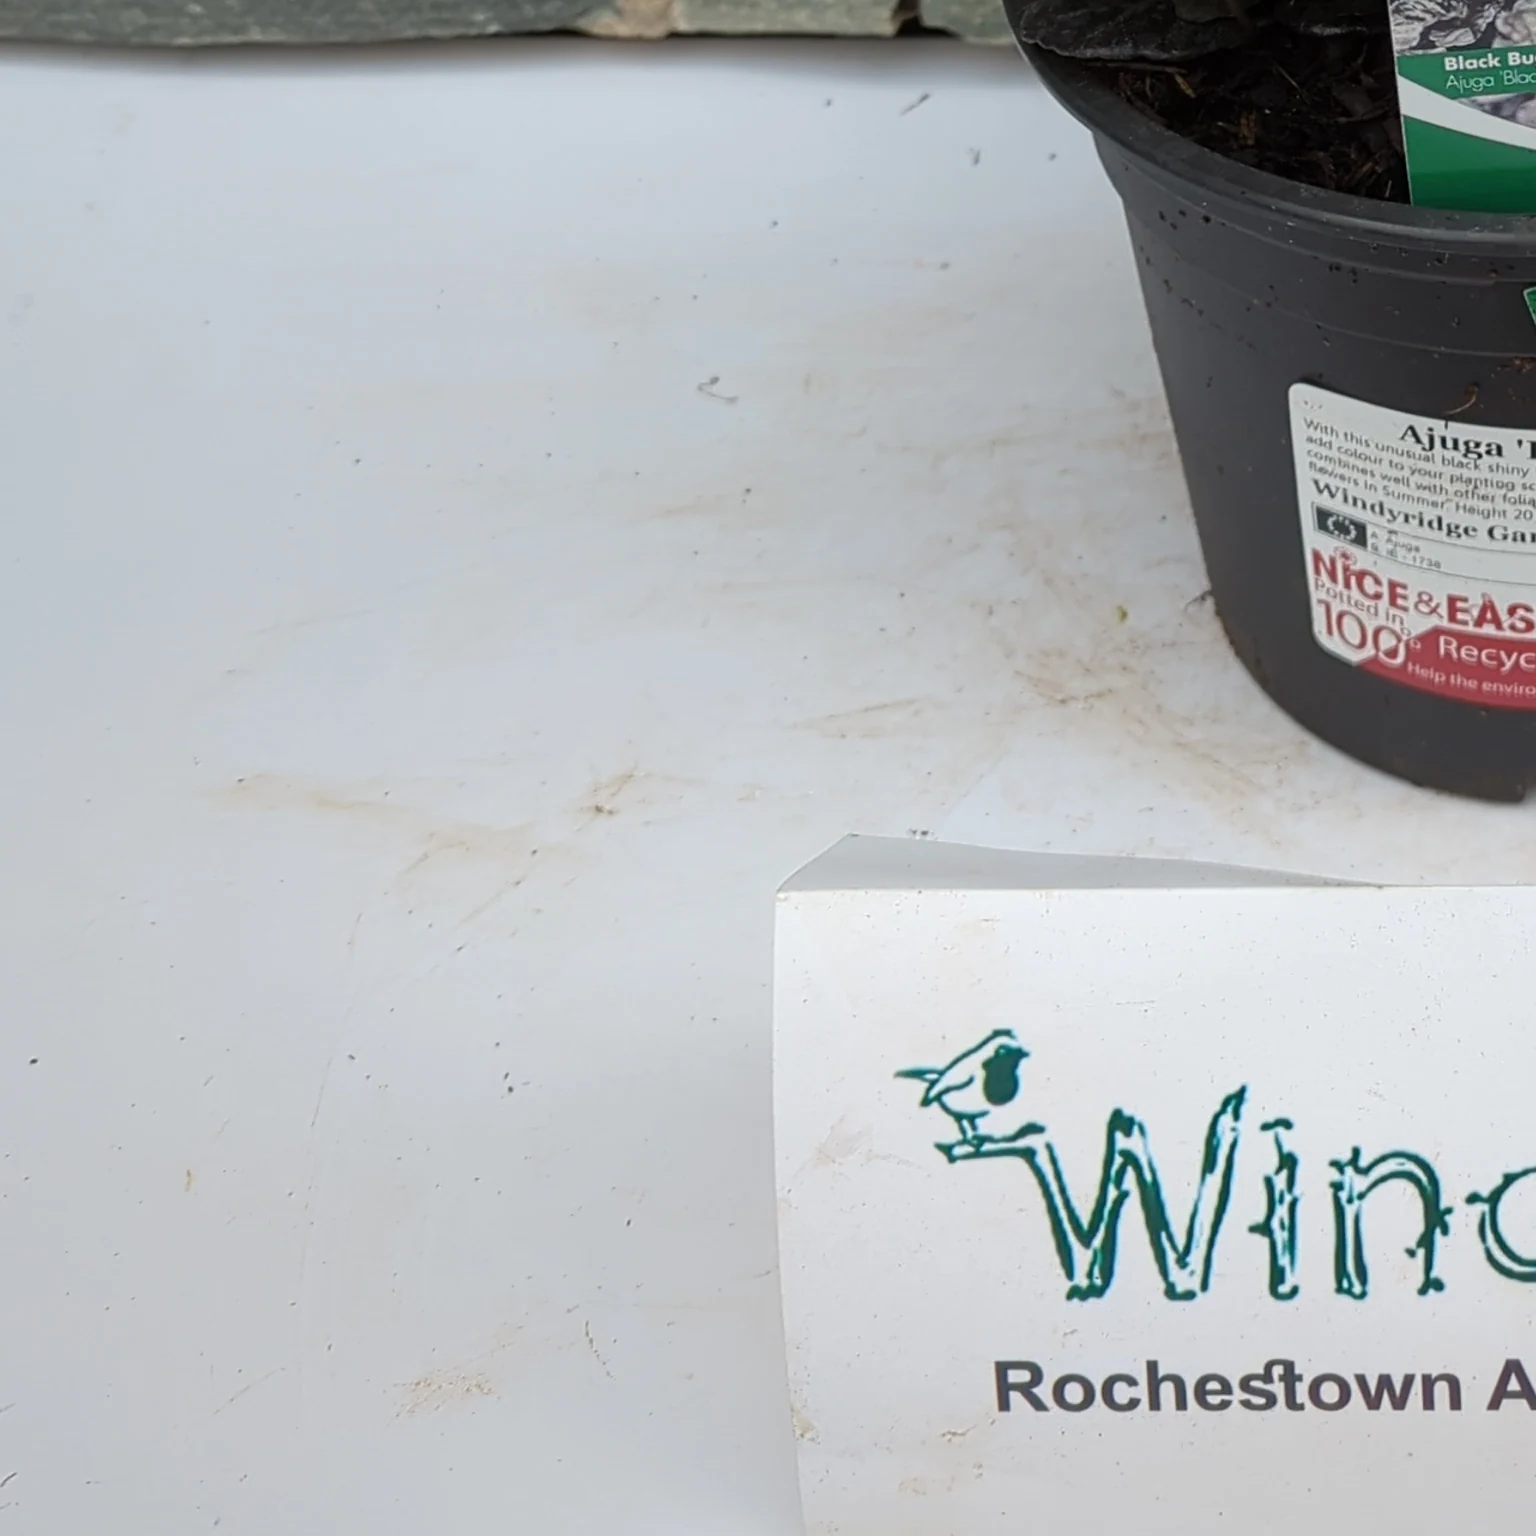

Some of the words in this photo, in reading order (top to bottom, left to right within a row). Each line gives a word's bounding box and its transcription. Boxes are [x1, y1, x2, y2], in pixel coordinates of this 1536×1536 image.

[1444, 53, 1501, 71] Black
[1446, 74, 1495, 93] Ajuga
[1303, 416, 1339, 439] With
[1343, 431, 1371, 448] this
[1374, 442, 1436, 465] unusual
[1441, 453, 1481, 471] black
[1488, 462, 1530, 478] shiny
[1305, 435, 1333, 451] add
[1337, 446, 1385, 465] colour
[1388, 457, 1408, 471] to
[1409, 464, 1444, 482] your
[1450, 472, 1516, 493] planting
[1399, 424, 1504, 461] Ajuga
[1306, 449, 1376, 478] combines
[1380, 473, 1410, 487] well
[1415, 479, 1449, 495] with
[1454, 488, 1496, 503] other
[1308, 461, 1359, 487] flowers
[1455, 502, 1507, 520] Height
[1514, 509, 1533, 521] 20
[1312, 478, 1478, 539] Windyridge
[1314, 577, 1379, 617] Potted
[1385, 609, 1405, 627] in
[1406, 661, 1446, 685] Help
[1450, 673, 1478, 690] the
[994, 1358, 1463, 1413] Rochestown
